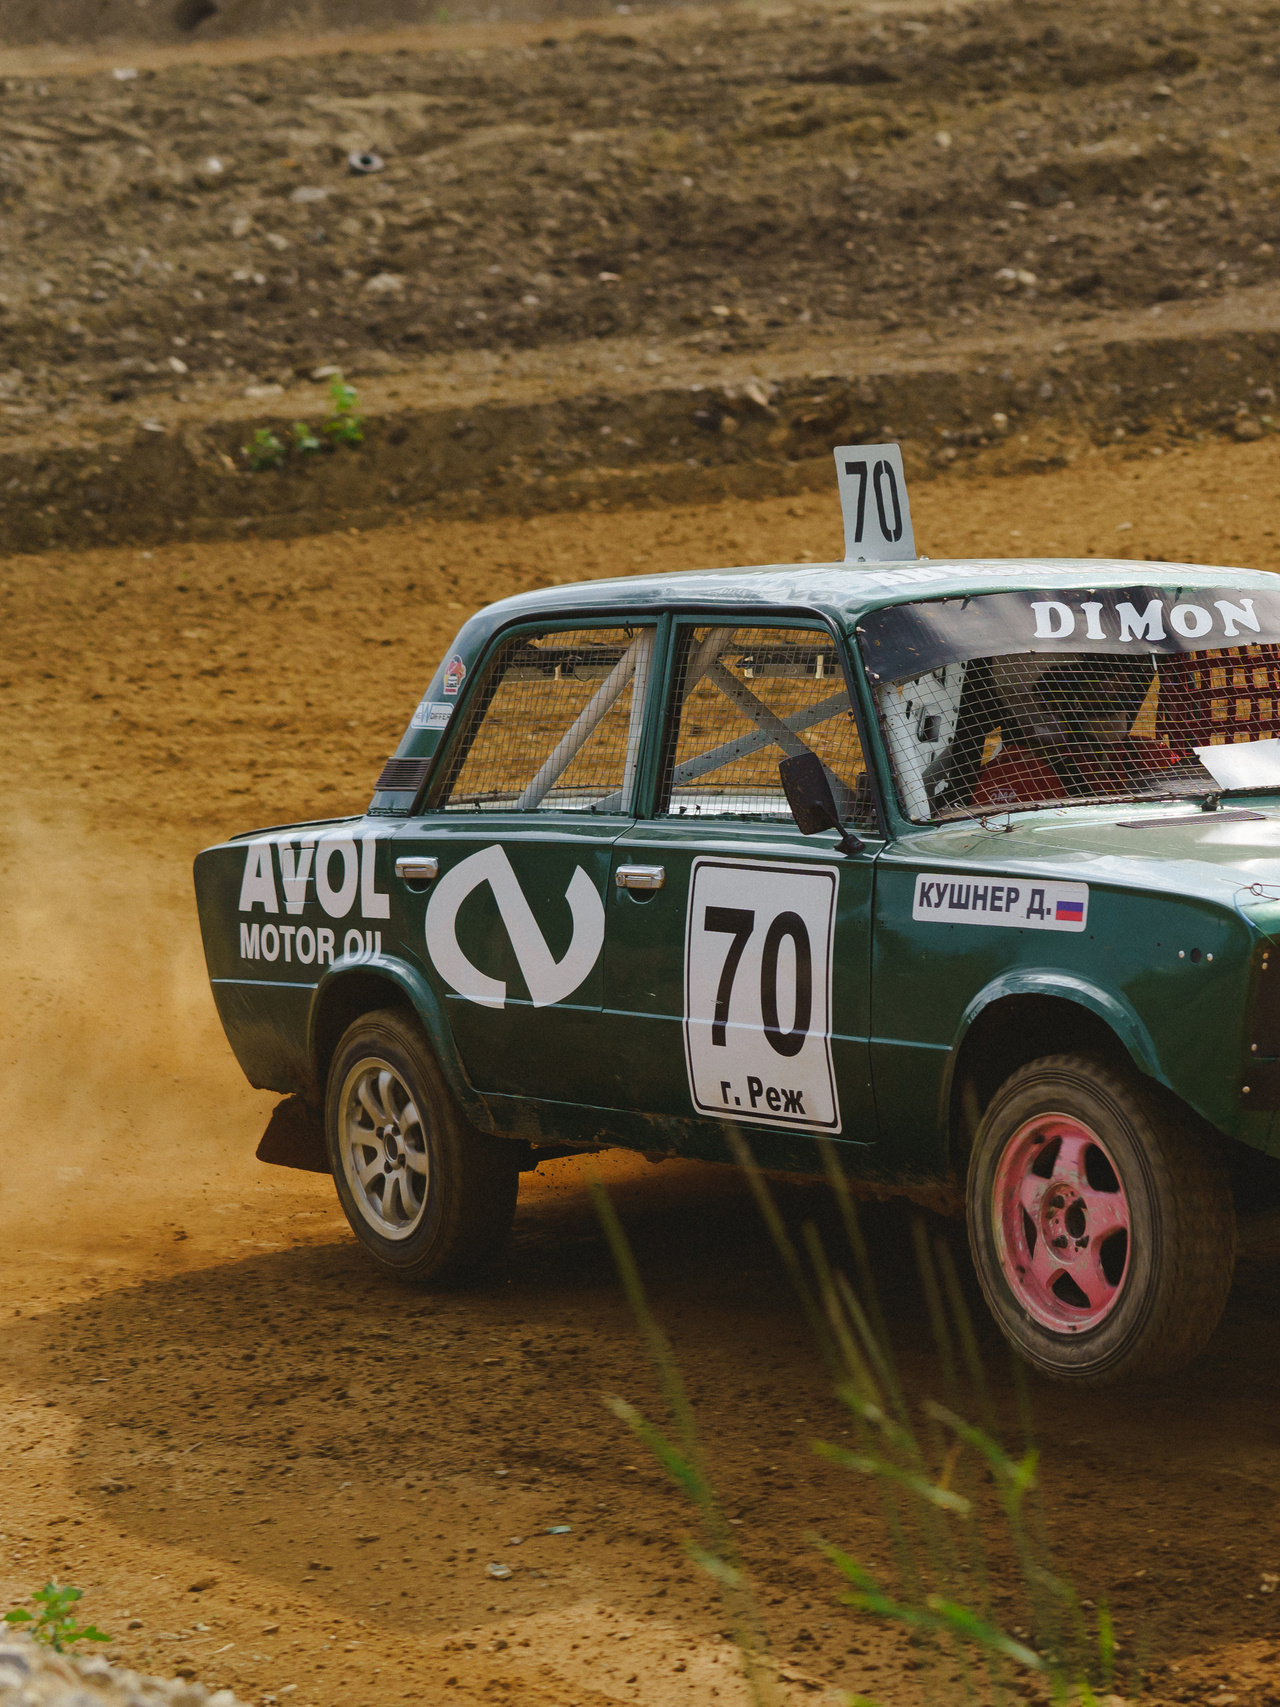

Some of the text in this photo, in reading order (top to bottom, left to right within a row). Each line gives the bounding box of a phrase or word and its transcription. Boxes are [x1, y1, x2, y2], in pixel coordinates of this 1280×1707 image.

[845, 460, 903, 543] 70
[1030, 598, 1261, 643] DIMON
[238, 830, 391, 920] AVOL
[918, 881, 1052, 921] КУШНЕР Д.
[239, 922, 388, 966] MOTOR OIL
[703, 905, 813, 1058] 70
[720, 1075, 807, 1115] г. Реж
